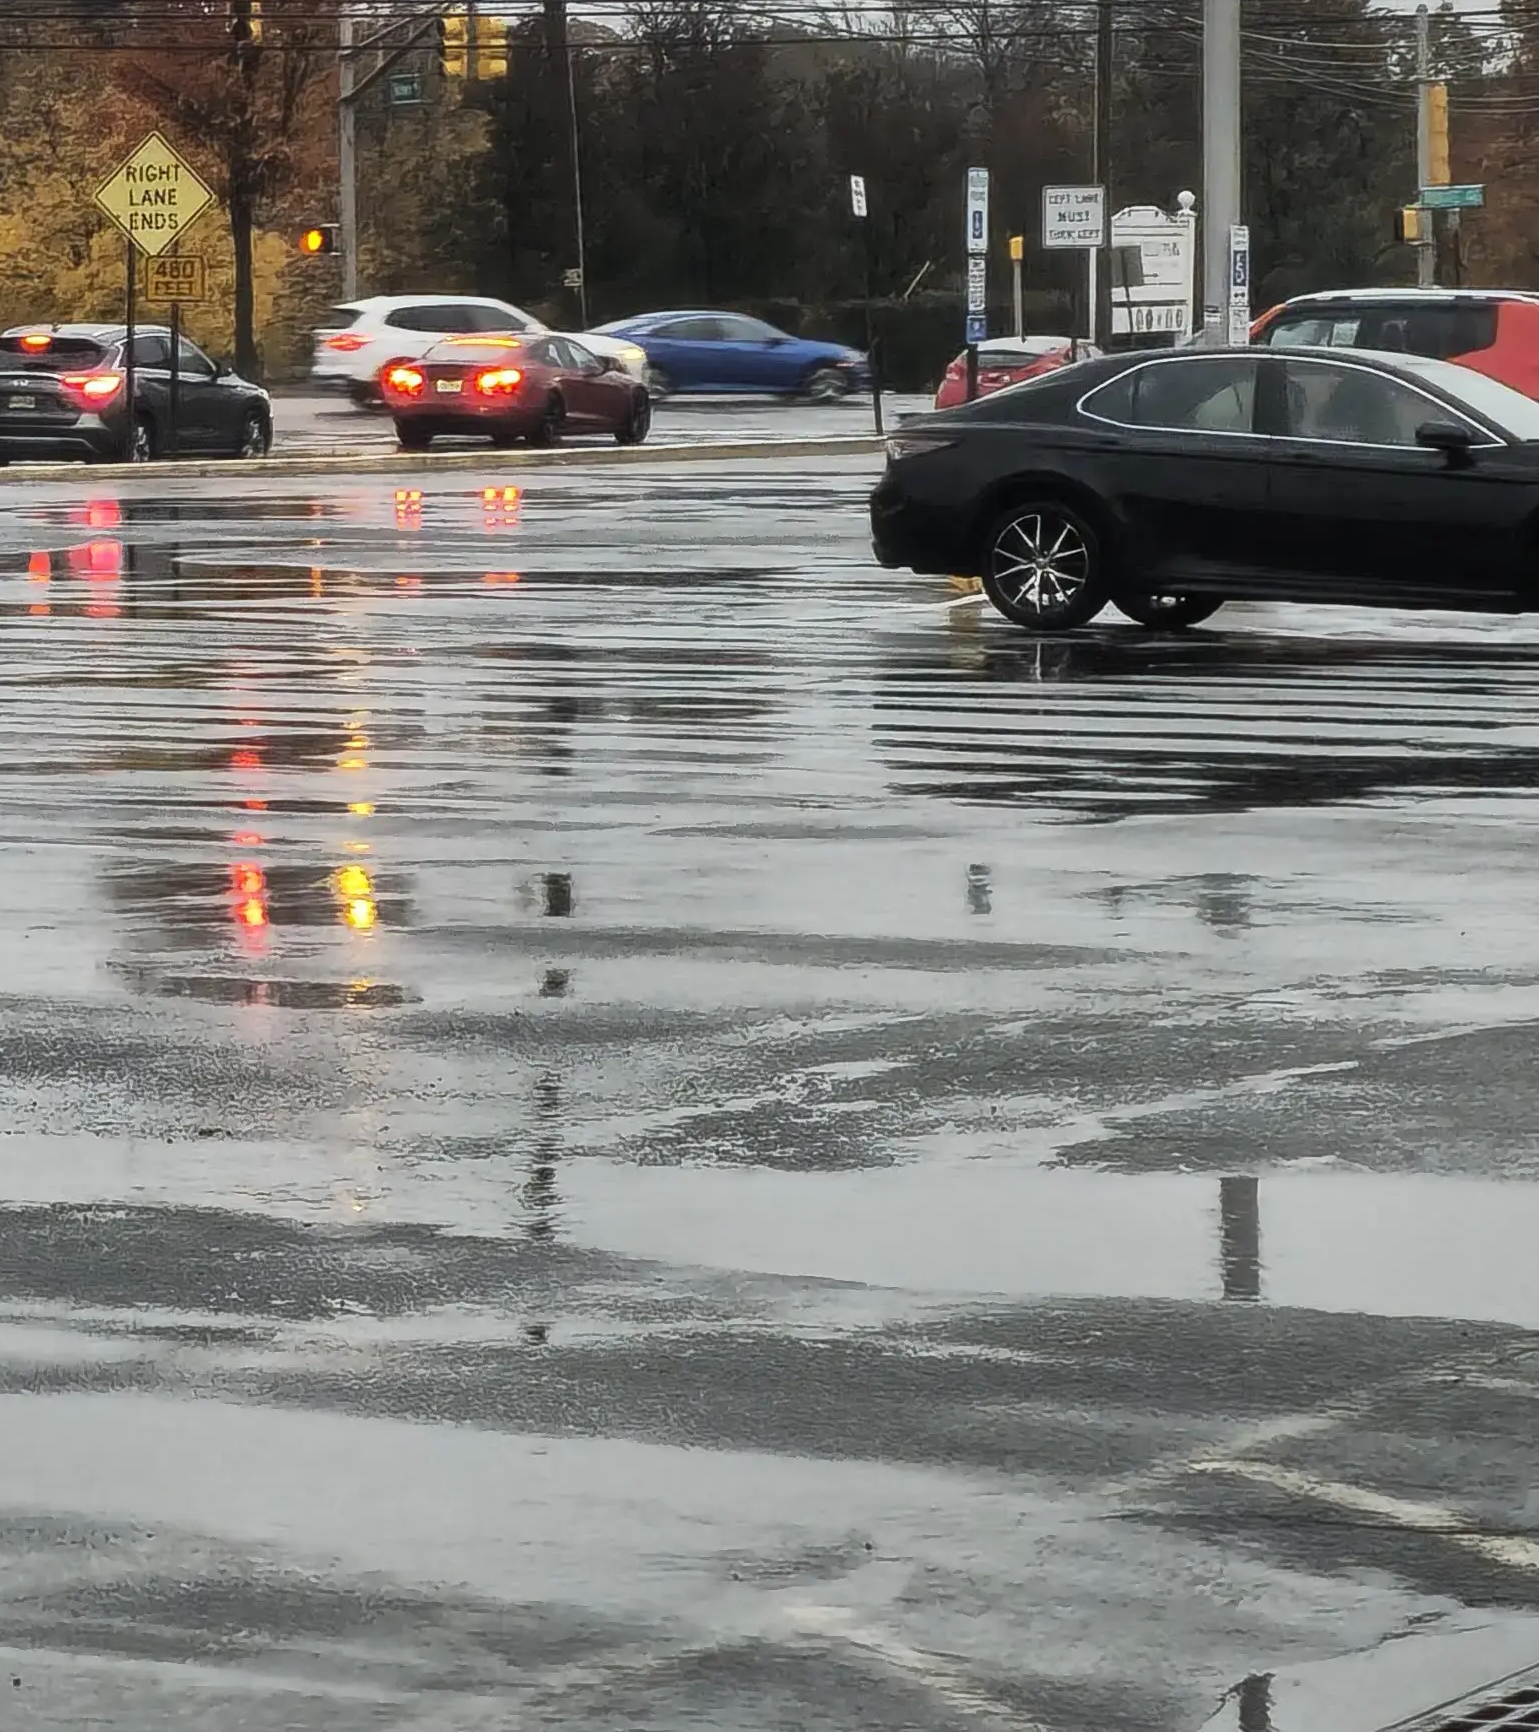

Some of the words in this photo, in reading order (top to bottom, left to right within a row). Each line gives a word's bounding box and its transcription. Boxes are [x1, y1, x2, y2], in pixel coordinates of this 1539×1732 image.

[125, 163, 180, 183] RIGHT
[128, 188, 178, 207] LANE
[128, 212, 179, 231] ENDS
